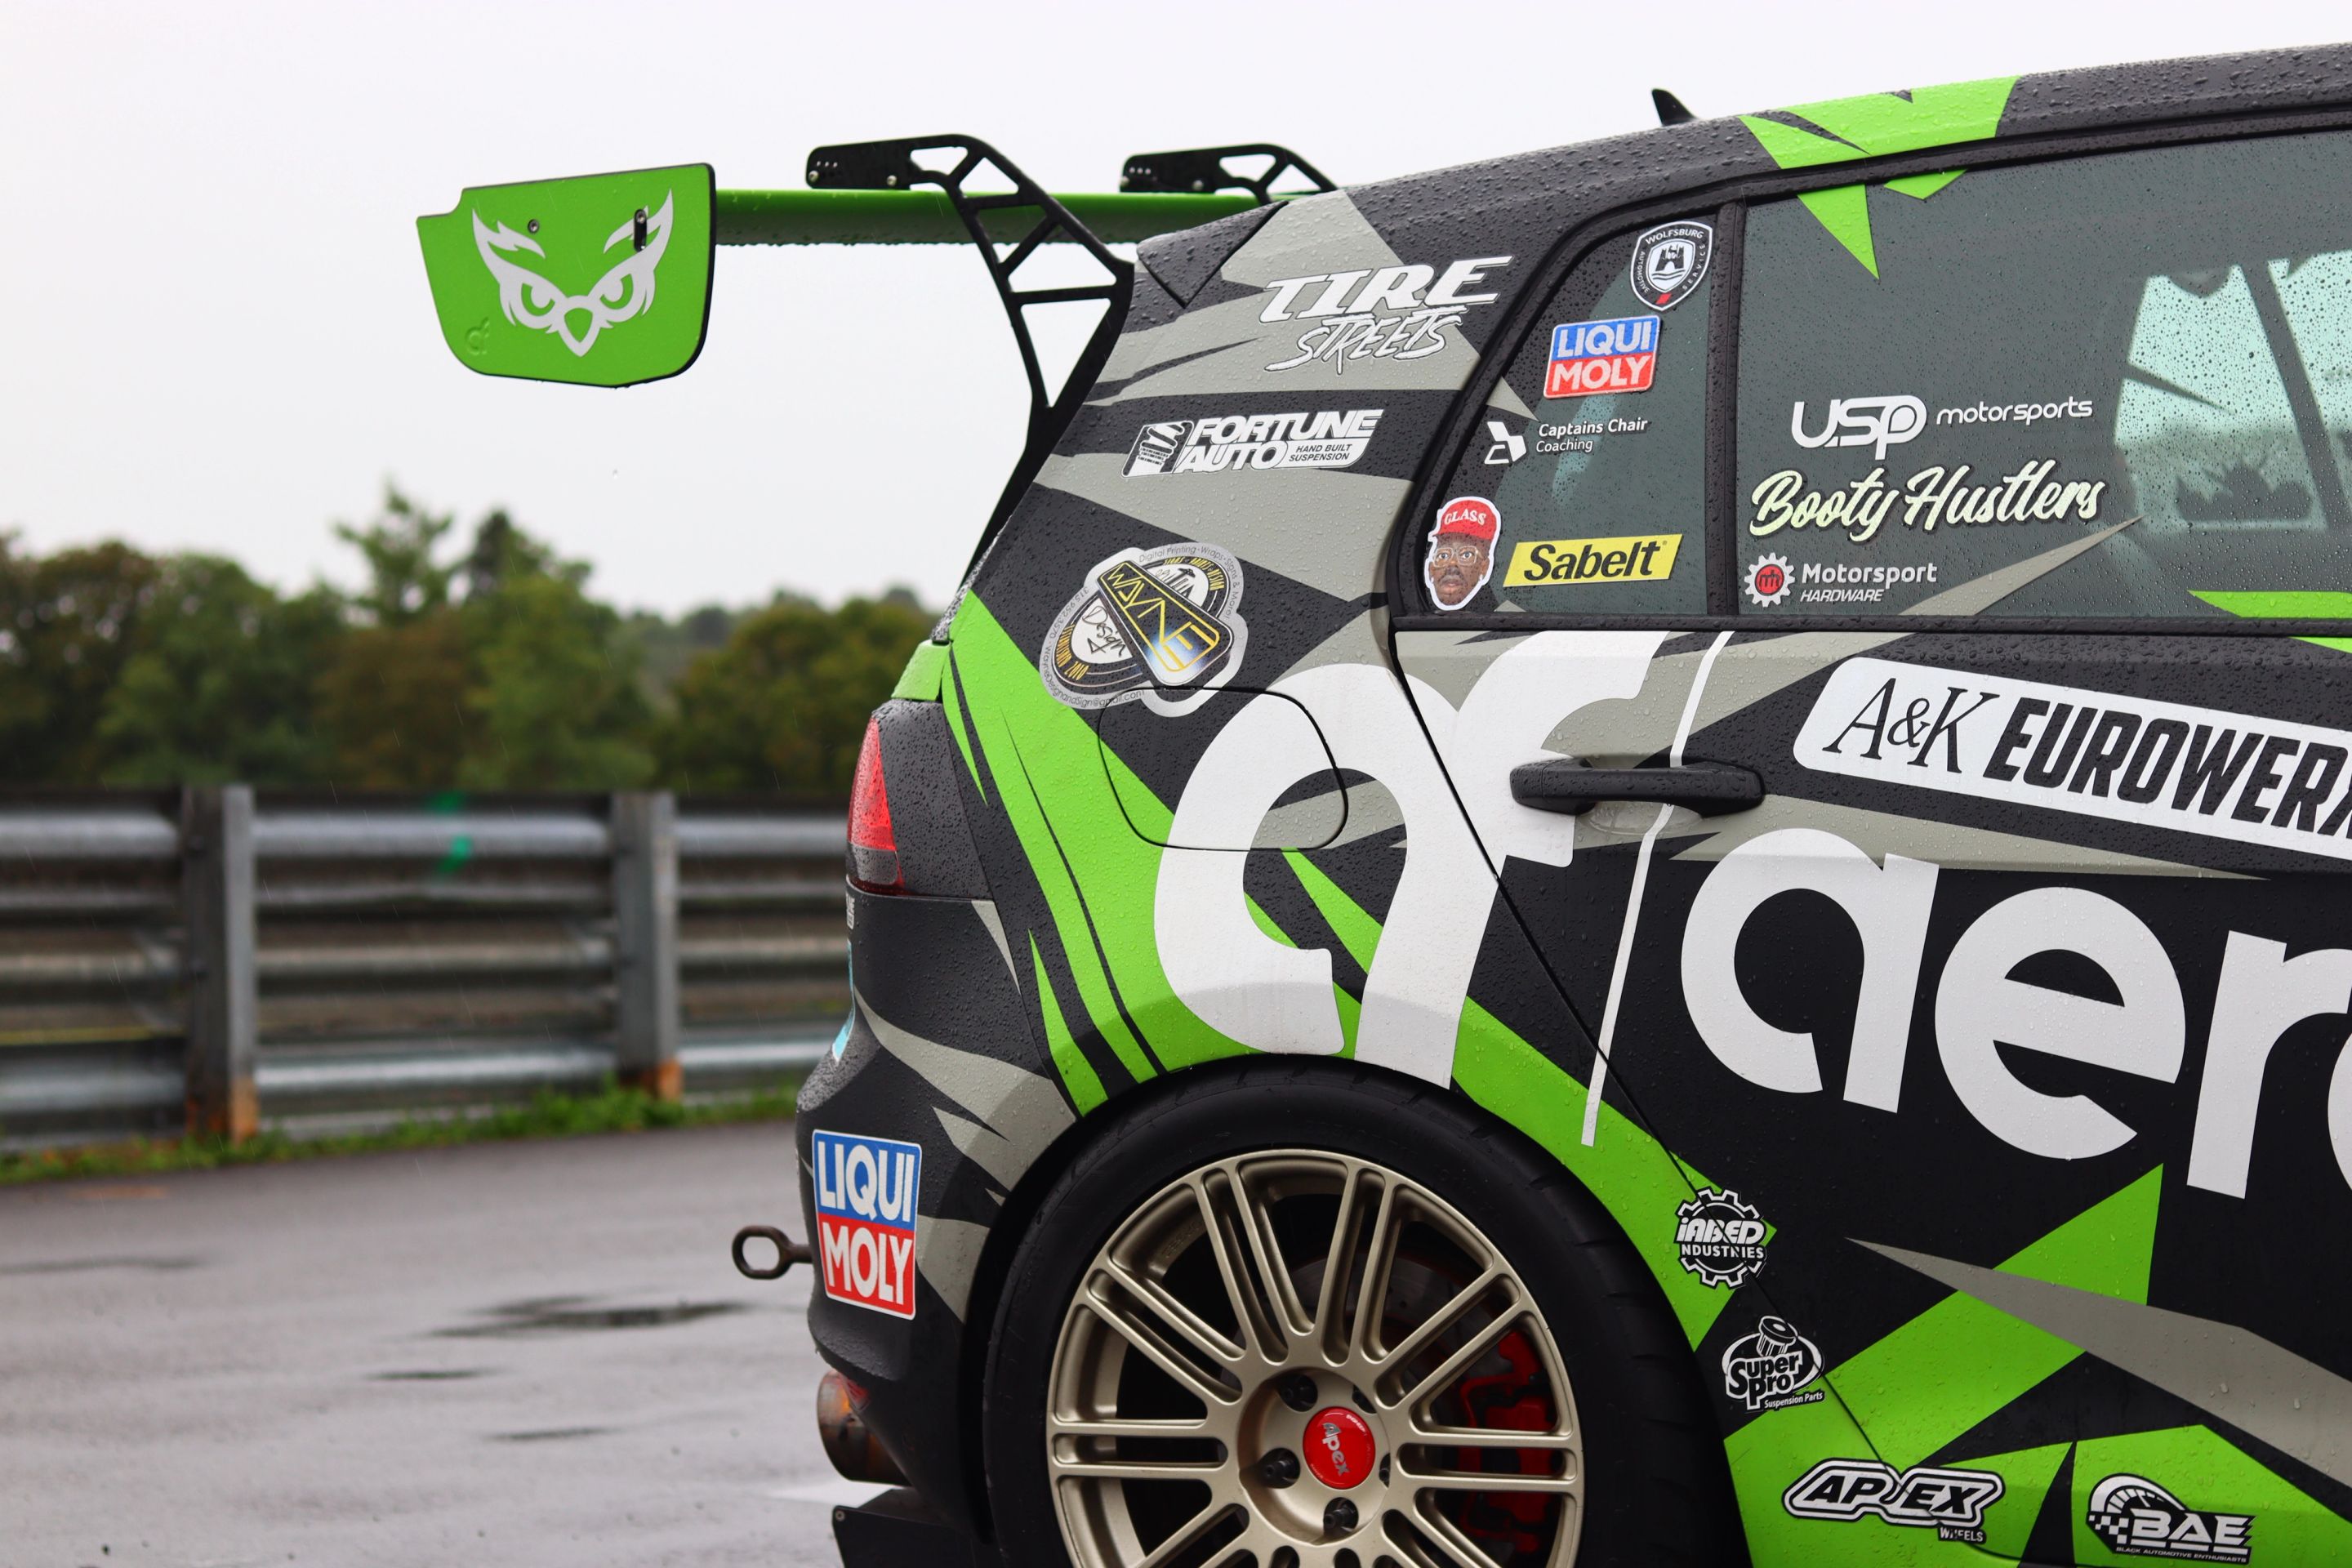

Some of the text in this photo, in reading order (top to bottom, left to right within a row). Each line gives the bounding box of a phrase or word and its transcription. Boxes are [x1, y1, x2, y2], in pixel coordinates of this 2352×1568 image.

[1645, 228, 1704, 245] WOLFSBURG
[1637, 251, 1650, 294] AUTOMOTIVE
[1682, 244, 1706, 291] SERVICE
[1258, 255, 1513, 323] TIRE
[1264, 304, 1468, 376] STREETS
[1557, 321, 1652, 359] LIQUI
[1552, 354, 1653, 391] MOLY
[1188, 409, 1384, 444] FORTUNE
[1539, 418, 1649, 439] Captains Chair
[1936, 395, 2094, 425] motorsports
[1176, 439, 1288, 473] AUTO
[1288, 452, 1350, 462] SUSPENSION
[1295, 443, 1352, 453] HAND BUILT
[1535, 438, 1594, 453] Coaching
[1443, 509, 1487, 527] GLASS
[1749, 459, 2105, 542] Booty Hustlers
[1524, 541, 1660, 581] Sabelt
[1802, 563, 1938, 590] Motorsport
[1800, 588, 1885, 602] HARDWARE
[1822, 677, 2000, 774] A&K
[1681, 827, 2352, 1199] aer
[817, 1141, 915, 1223] LIQUI
[822, 1221, 913, 1305] MOLY
[1728, 1353, 1802, 1396] Super
[1764, 1392, 1824, 1409] Suspension Parts
[1802, 1474, 1983, 1515] APEX
[2130, 1508, 2249, 1545] BAE
[2116, 1546, 2247, 1563] BLACK AUTOMOTIVE ENTHUSIASTS
